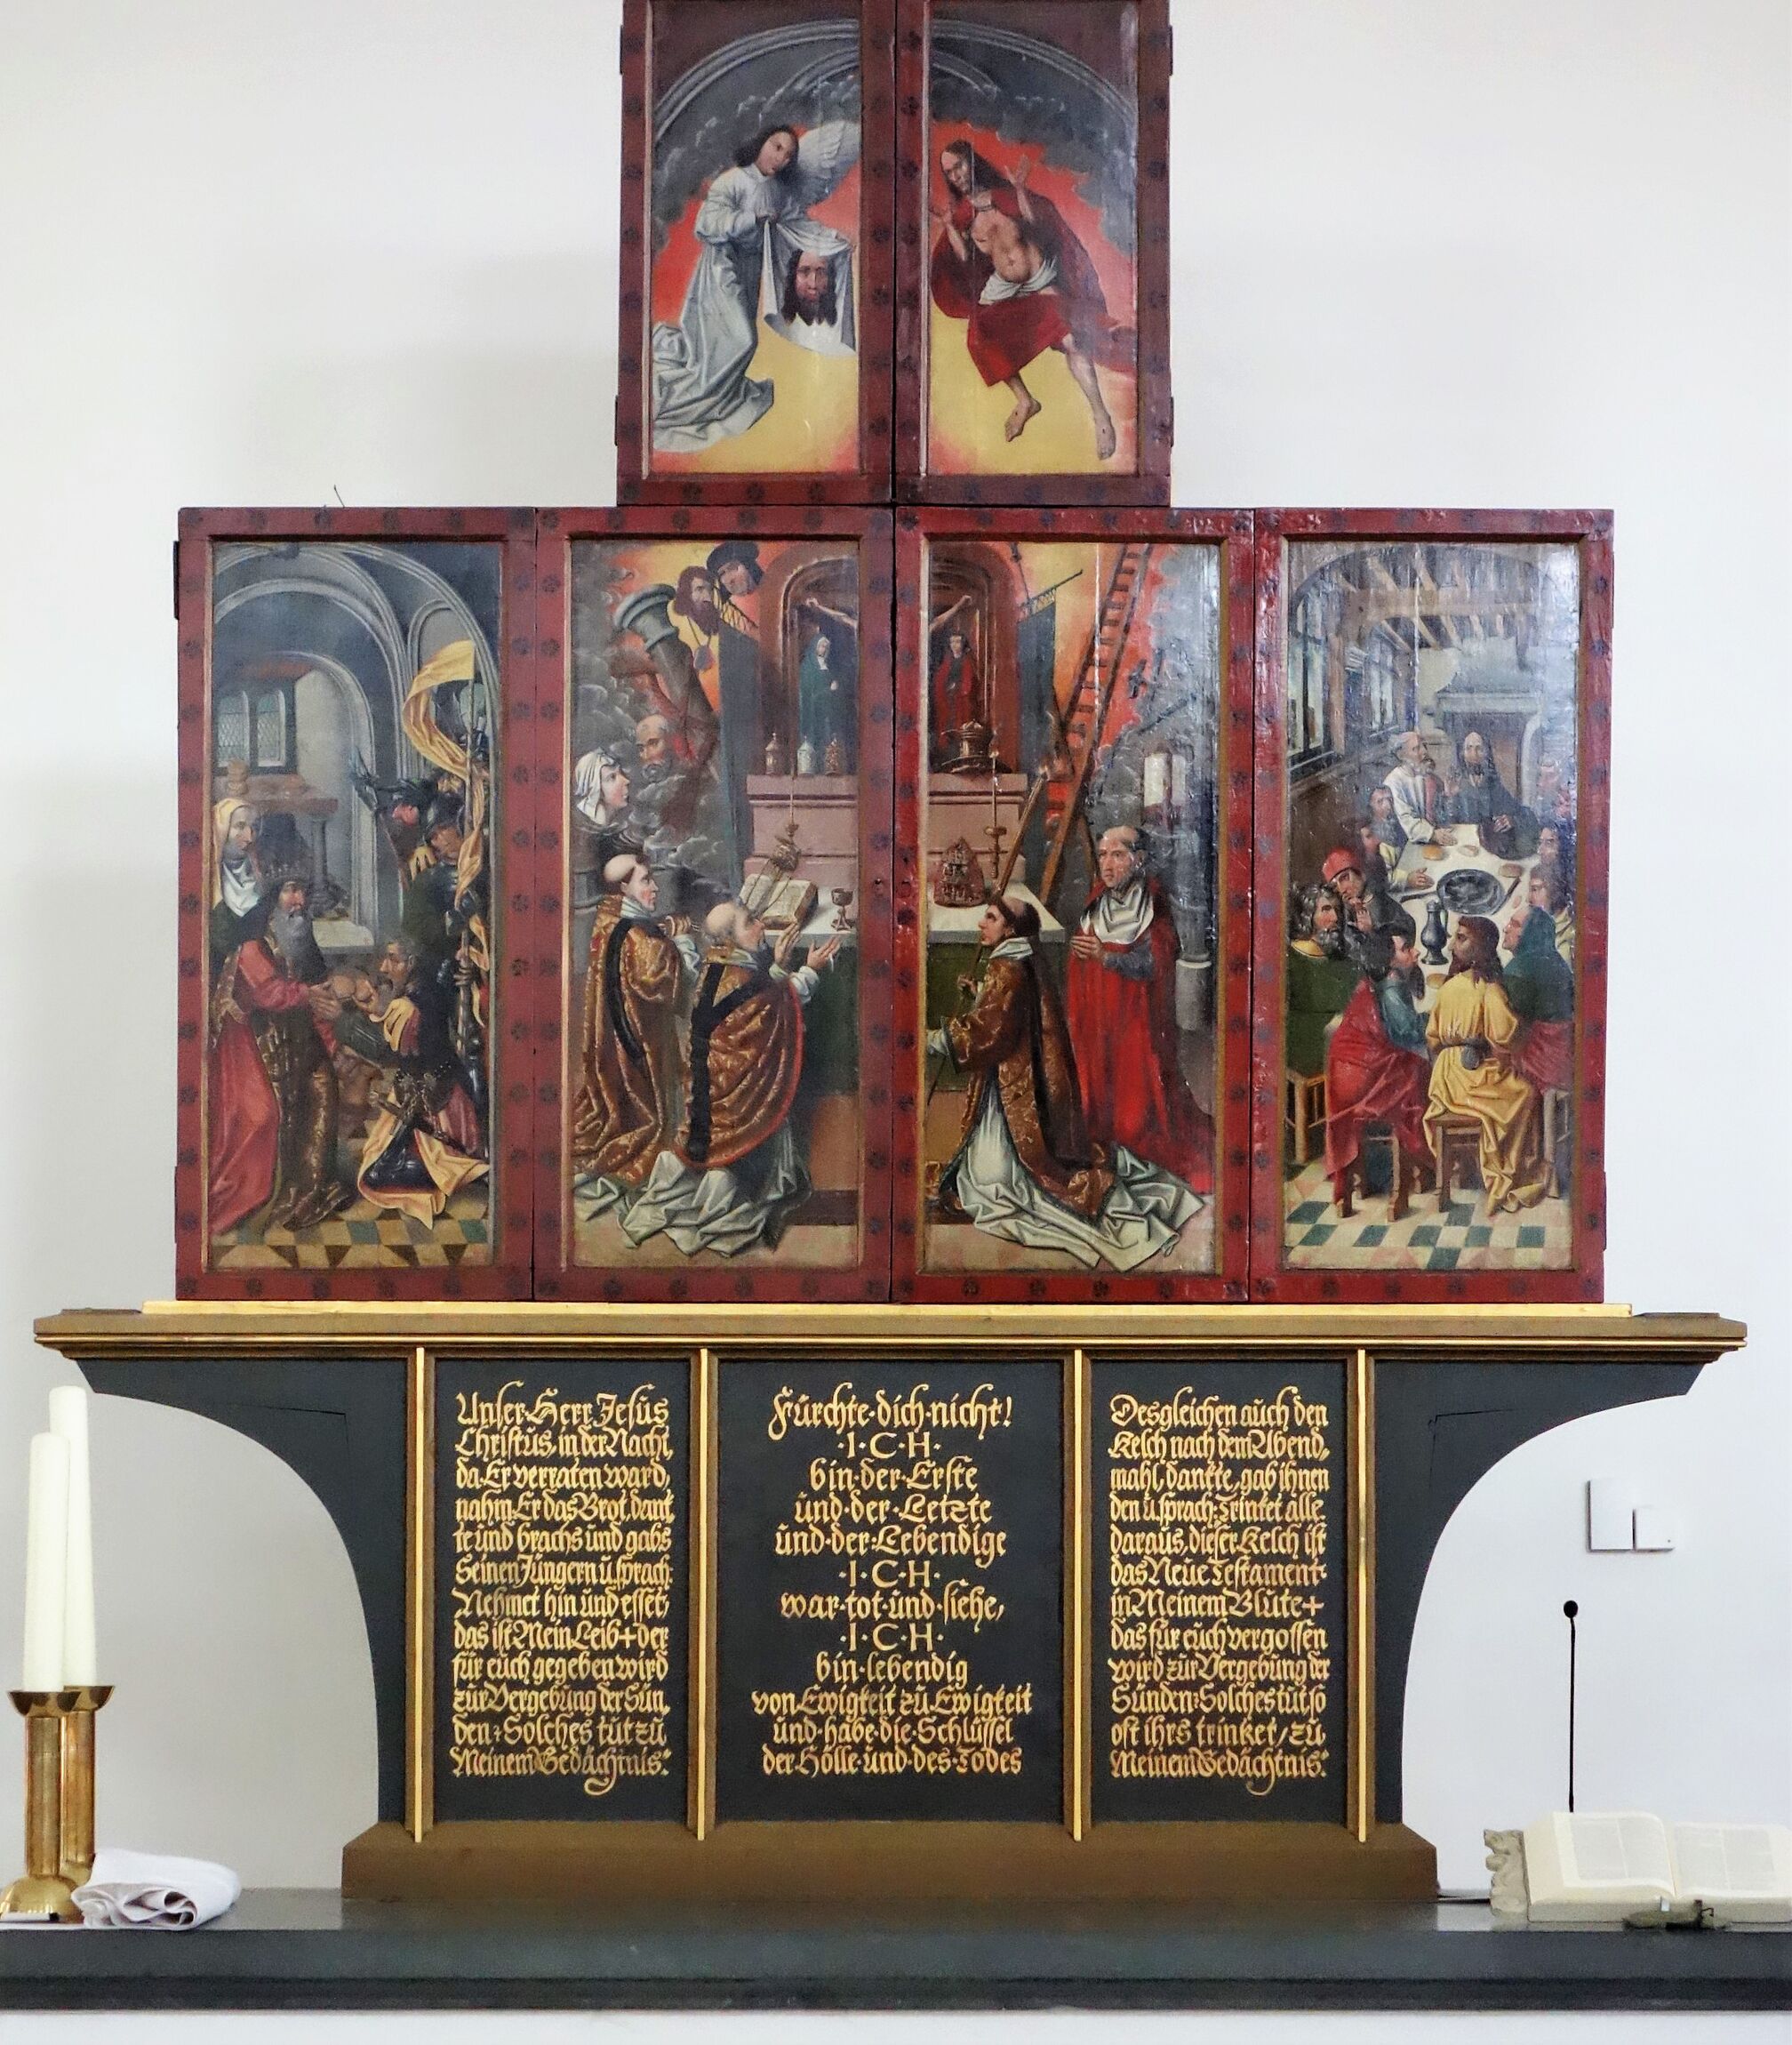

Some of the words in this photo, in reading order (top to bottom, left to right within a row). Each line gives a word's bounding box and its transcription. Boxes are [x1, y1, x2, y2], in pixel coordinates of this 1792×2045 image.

[525, 1388, 593, 1427] Herr
[768, 1382, 869, 1441] Fürchte
[877, 1383, 929, 1432] dich
[1110, 1386, 1236, 1432] Desgleichen
[1293, 1395, 1329, 1427] den
[559, 1428, 578, 1456] in
[579, 1423, 605, 1456] der
[1108, 1427, 1166, 1464] Kelch
[1171, 1432, 1216, 1465] nach
[1218, 1428, 1251, 1459] dem
[456, 1457, 479, 1489] da
[480, 1459, 512, 1490] Er
[514, 1457, 603, 1491] verraten
[810, 1458, 855, 1491] bin
[860, 1458, 900, 1491] der
[1240, 1461, 1278, 1495] gab
[1279, 1461, 1330, 1496] ihnen
[455, 1489, 513, 1527] nahm
[512, 1492, 541, 1521] Er
[542, 1489, 577, 1521] das
[850, 1489, 891, 1525] der
[900, 1493, 993, 1524] Letzte
[1109, 1491, 1139, 1521] den
[1215, 1491, 1283, 1522] Trinket
[452, 1522, 475, 1552] te
[517, 1520, 582, 1555] brachs
[627, 1523, 671, 1556] gabs
[830, 1522, 868, 1557] der
[875, 1523, 1006, 1568] Lebendige
[1236, 1524, 1300, 1560] Kelch
[456, 1555, 520, 1585] Seinen
[514, 1554, 597, 1591] Jüngern
[1111, 1555, 1148, 1586] das
[452, 1585, 540, 1620] Nehmet
[544, 1588, 578, 1622] hin
[781, 1592, 839, 1620] war
[844, 1591, 883, 1620] tot
[1111, 1588, 1131, 1617] in
[1131, 1588, 1228, 1617] Meinem
[454, 1620, 488, 1650] das
[513, 1620, 572, 1650] Mein
[571, 1619, 620, 1651] Leib
[632, 1623, 668, 1651] der
[1110, 1617, 1147, 1651] das
[1148, 1620, 1180, 1658] für
[452, 1650, 483, 1687] für
[532, 1656, 615, 1686] gegeben
[615, 1651, 668, 1682] wird
[816, 1651, 859, 1683] bin
[867, 1650, 967, 1688] lebendig
[1108, 1651, 1164, 1682] wird
[1308, 1651, 1330, 1680] der
[597, 1681, 622, 1712] der
[752, 1690, 796, 1716] von
[797, 1683, 897, 1721] Ewigkeit
[931, 1682, 1033, 1721] Ewigkeit
[1199, 1682, 1275, 1720] Solches
[452, 1713, 489, 1745] den
[504, 1713, 592, 1751] Solches
[825, 1717, 876, 1751] habe
[879, 1716, 911, 1744] die
[1111, 1716, 1140, 1750] oft
[1144, 1715, 1190, 1751] ihrs
[450, 1746, 536, 1776] Meinem
[762, 1744, 795, 1776] der
[796, 1744, 858, 1778] Hölle
[913, 1745, 951, 1775] des
[954, 1746, 1022, 1776] Todes
[1110, 1746, 1198, 1777] Meinem
